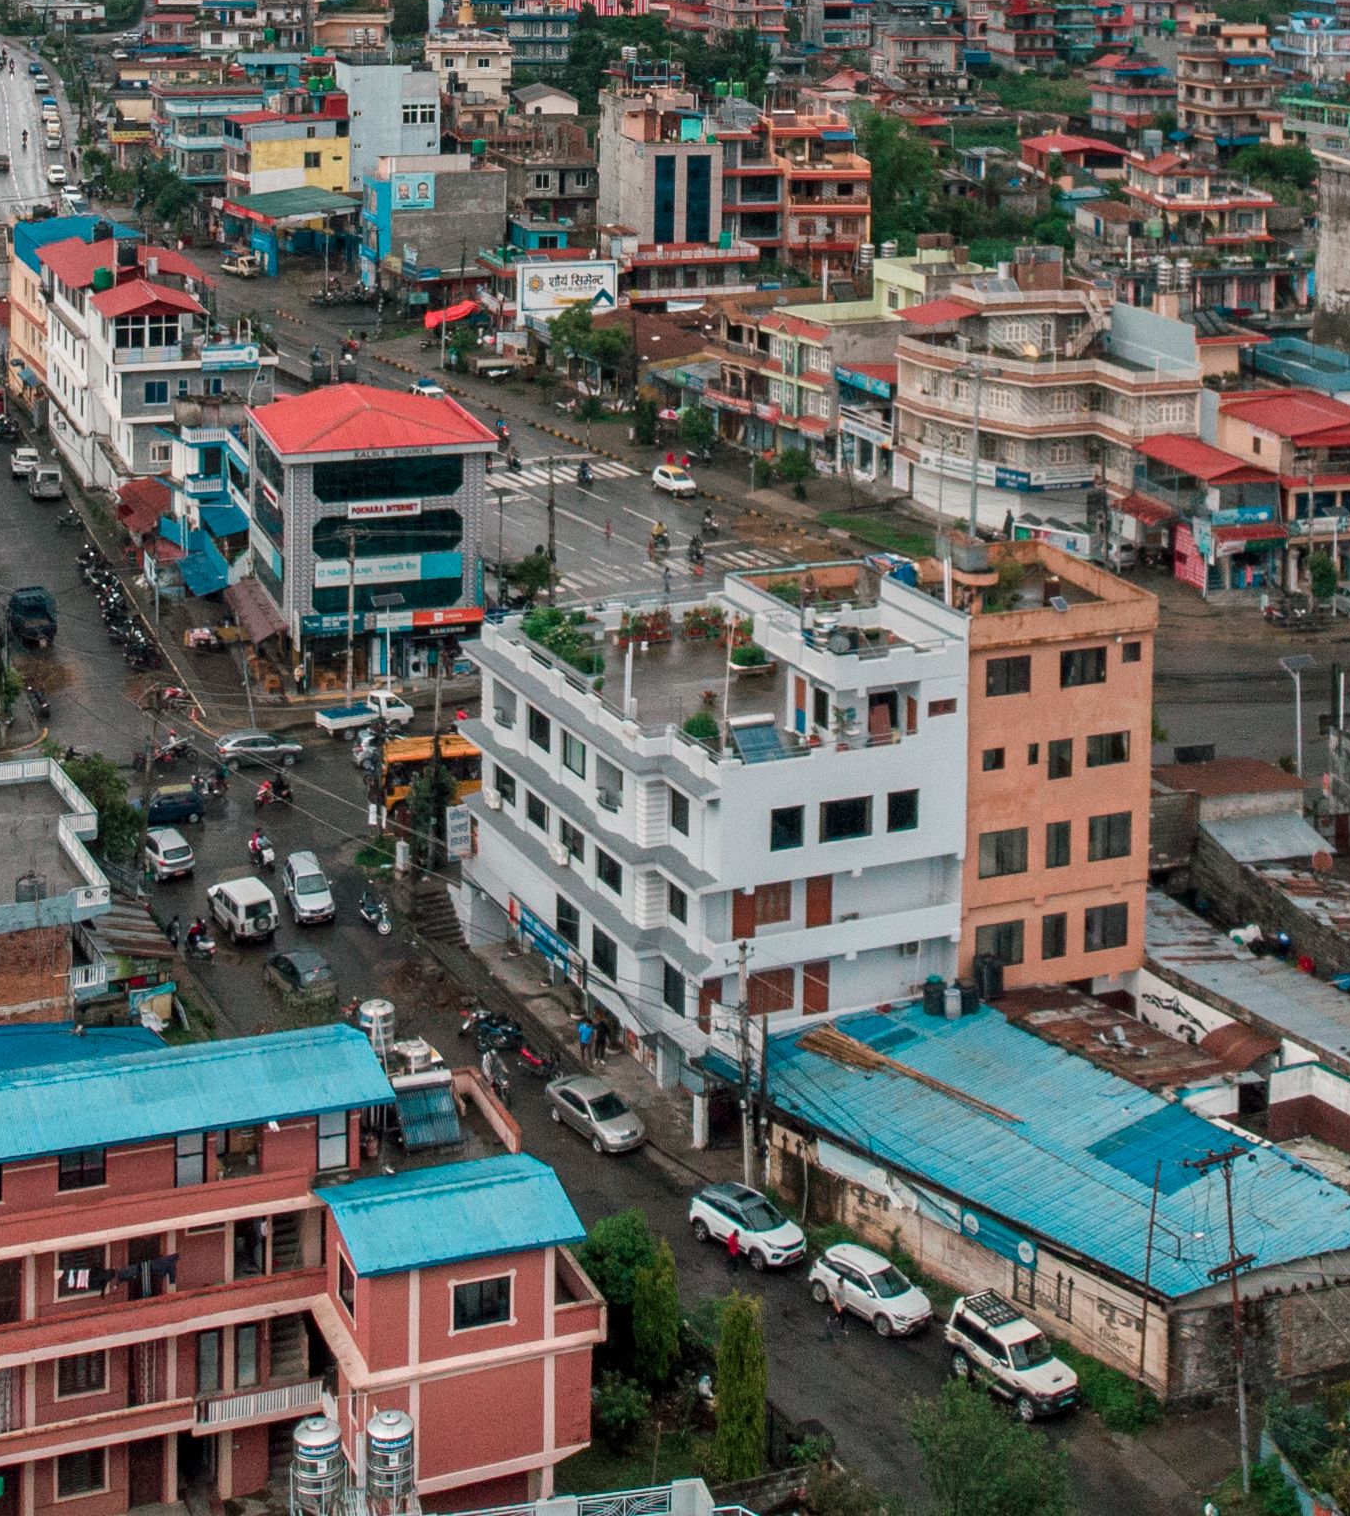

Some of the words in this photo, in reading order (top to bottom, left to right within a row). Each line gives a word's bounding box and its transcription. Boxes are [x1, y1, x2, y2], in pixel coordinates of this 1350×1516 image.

[354, 449, 387, 458] KALIKA
[351, 504, 384, 515] POKHARA
[386, 503, 419, 513] INTERNET
[430, 626, 466, 635] SAMSUNG
